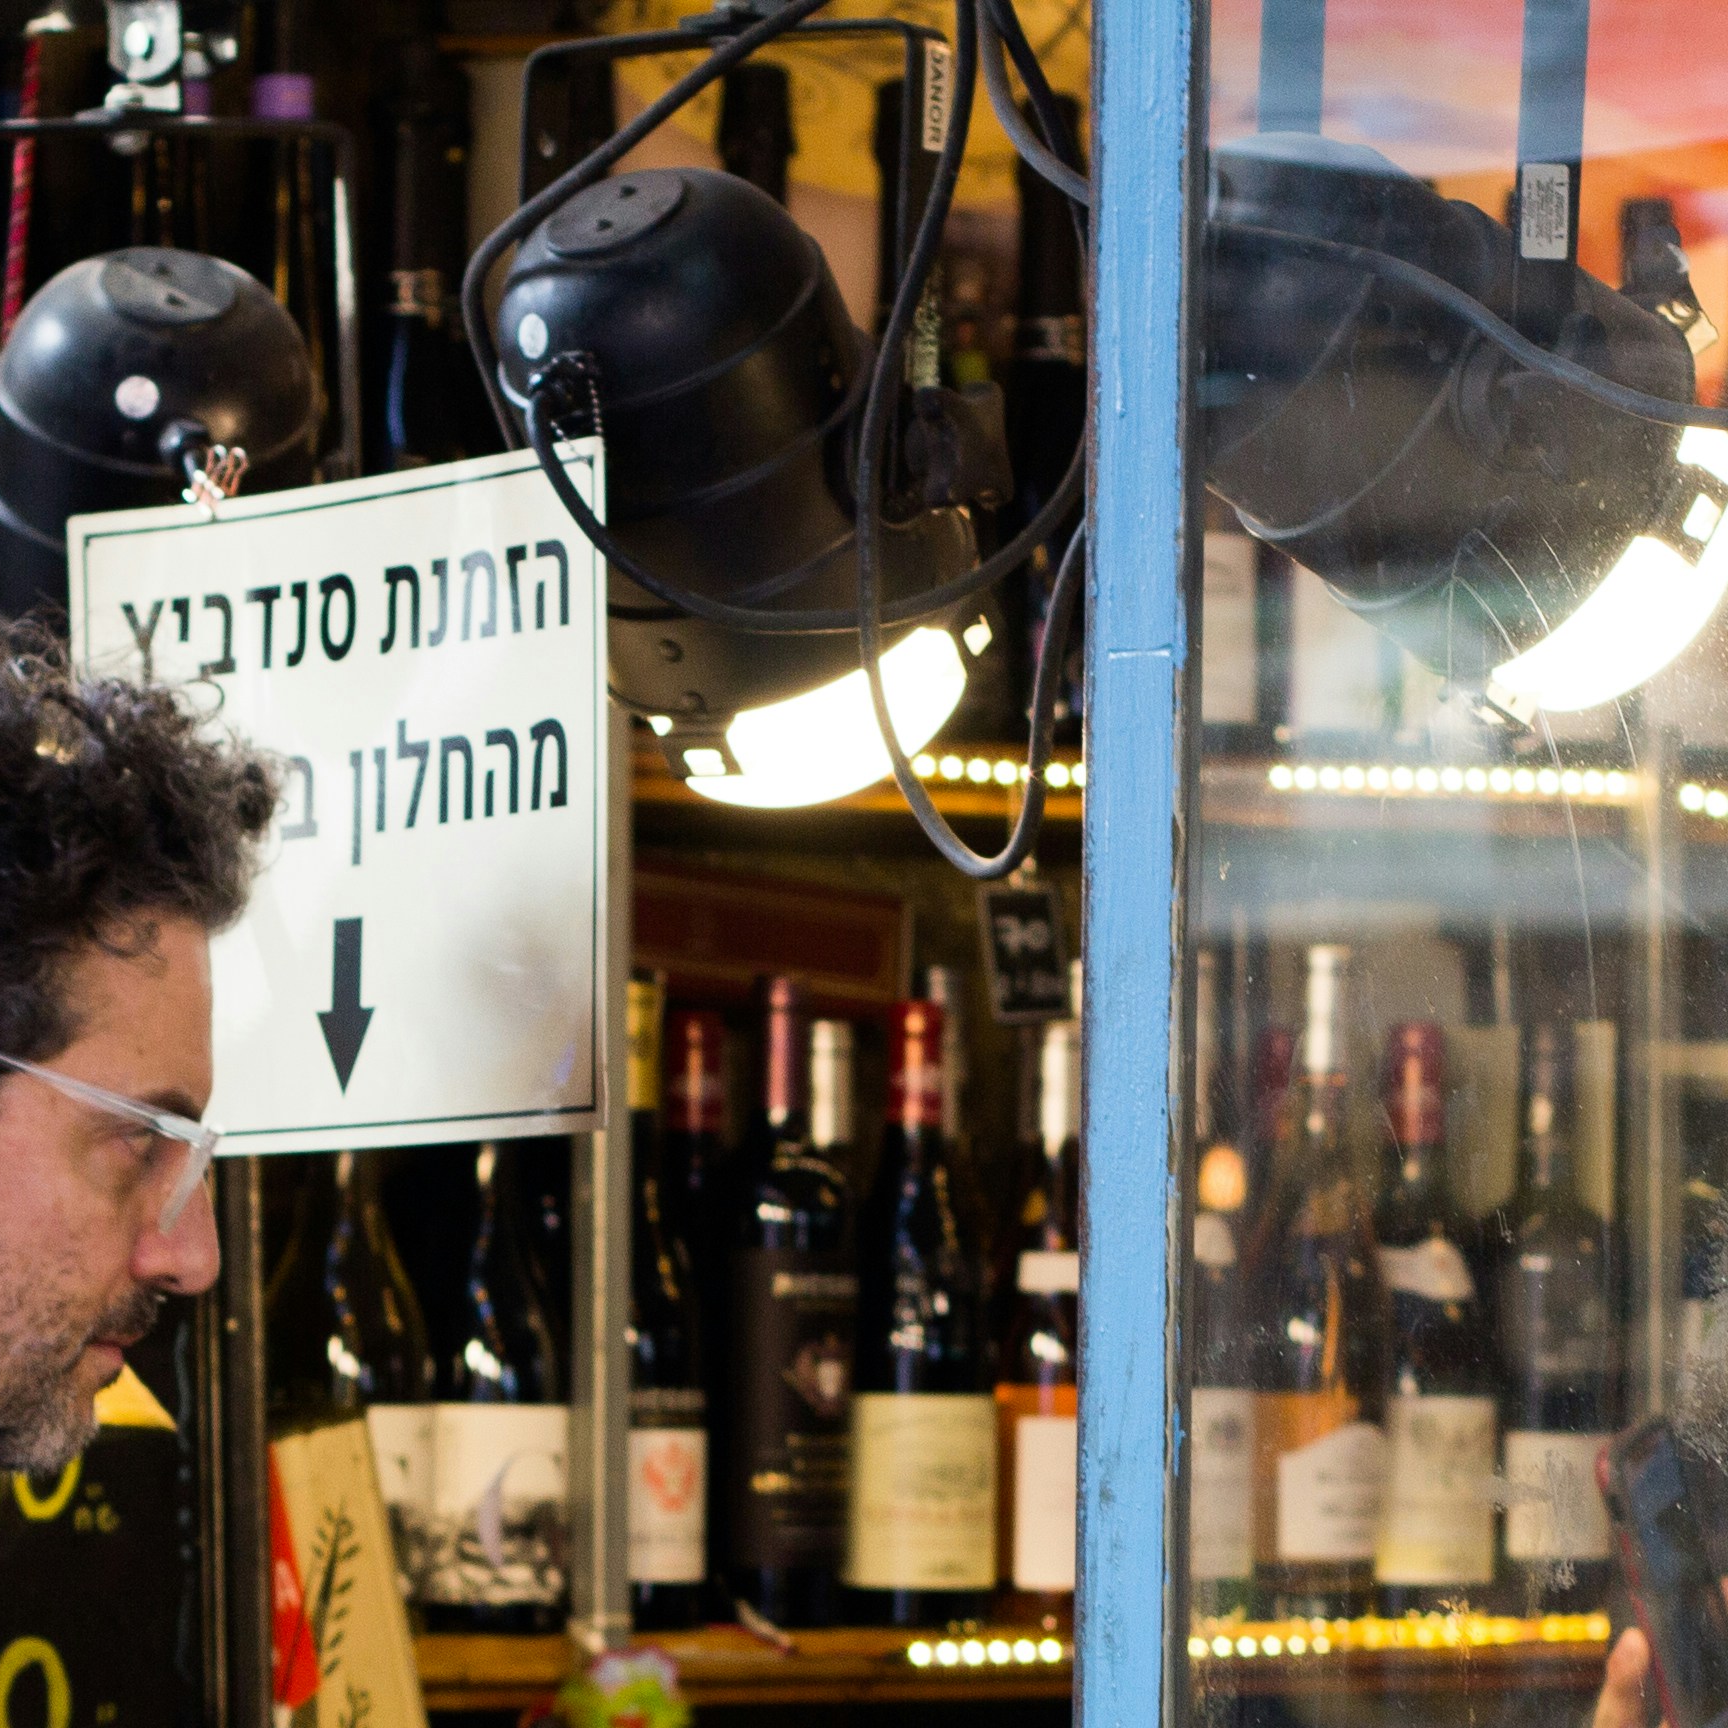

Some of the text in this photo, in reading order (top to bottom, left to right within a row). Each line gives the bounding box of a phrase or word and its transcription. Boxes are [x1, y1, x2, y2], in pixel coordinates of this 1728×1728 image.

[122, 538, 571, 686] הזמנת סנדביץ
[350, 716, 569, 866] מהחלון
